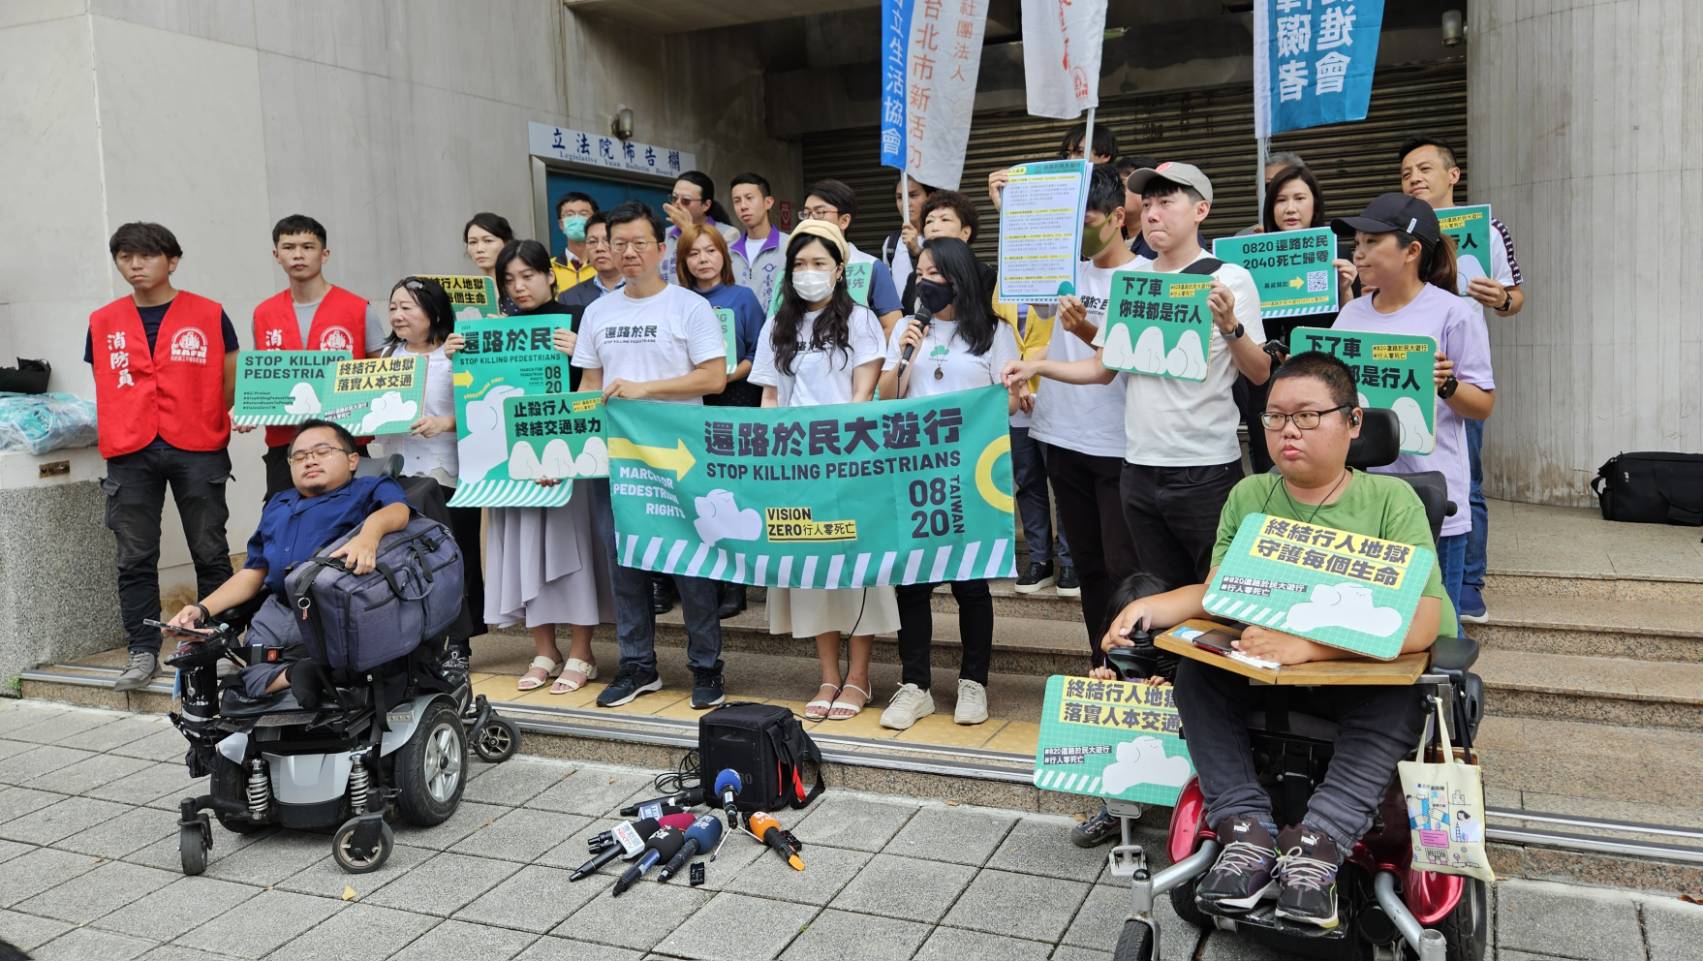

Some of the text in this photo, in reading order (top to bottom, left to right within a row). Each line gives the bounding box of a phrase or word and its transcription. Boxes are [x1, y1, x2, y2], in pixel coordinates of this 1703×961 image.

[882, 0, 904, 156] 立生活協會
[1123, 277, 1163, 297] 下了車
[1120, 299, 1202, 324] 你我都是行人
[107, 331, 135, 389] 消防員
[245, 356, 282, 366] STOP
[339, 357, 414, 376] 終結行人地獄
[460, 353, 561, 366] STOP KILLING PEDESTRIANS
[337, 374, 412, 392] 落實人本交通
[545, 366, 561, 379] 08
[545, 381, 562, 394] 20
[513, 399, 571, 418] 止殺行人
[514, 417, 601, 438] 終結交通暴力
[704, 407, 963, 457] 還路於民大遊行
[706, 450, 961, 481] STOP KILLING PEDESTRIANS
[908, 477, 947, 508] 08
[950, 474, 965, 534] TAIWAN
[767, 508, 811, 521] VISION
[911, 509, 950, 539] 20
[1263, 518, 1410, 564] 終結行人地獄
[1256, 538, 1401, 586] 守護每個生命
[1064, 702, 1181, 732] 落實人本交通
